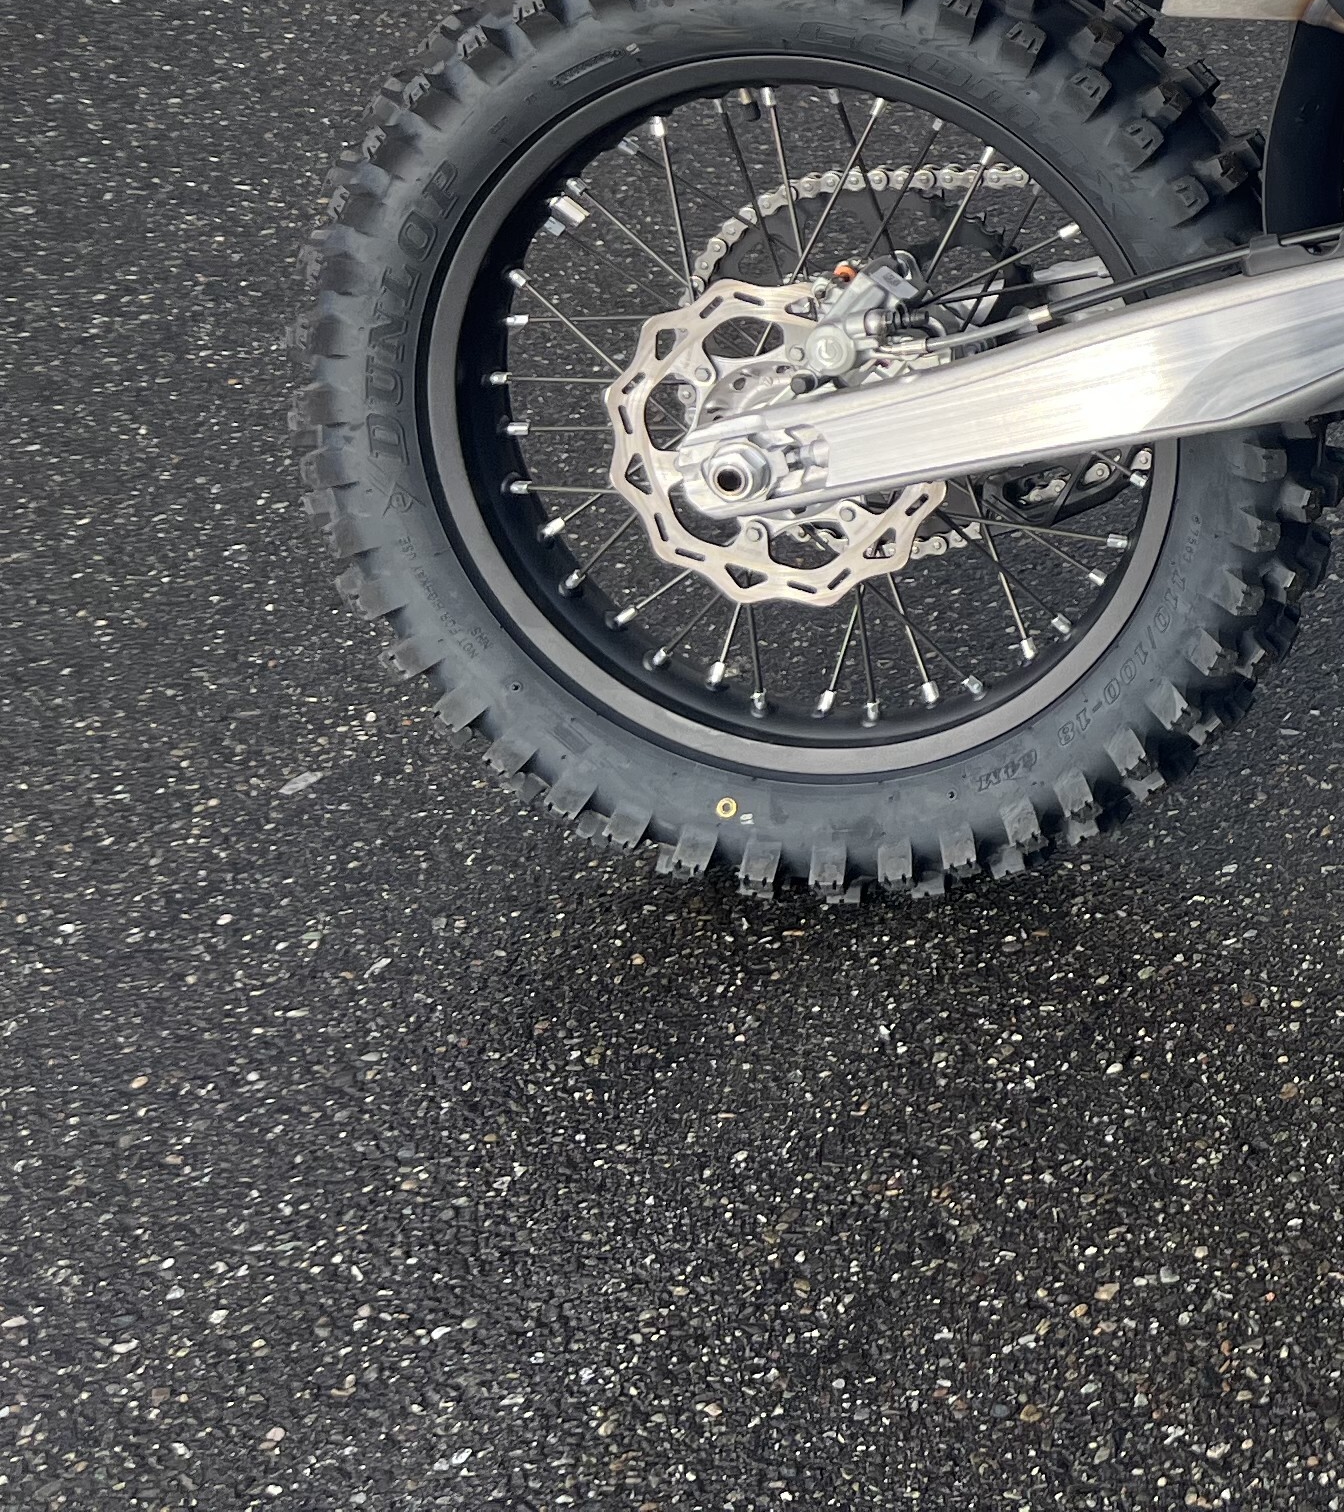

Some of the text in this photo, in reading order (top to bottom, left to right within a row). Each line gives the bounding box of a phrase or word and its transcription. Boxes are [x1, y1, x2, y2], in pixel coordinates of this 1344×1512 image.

[366, 159, 459, 466] DUNLOP
[456, 637, 480, 660] NOT
[1057, 566, 1188, 747] 110/100-18
